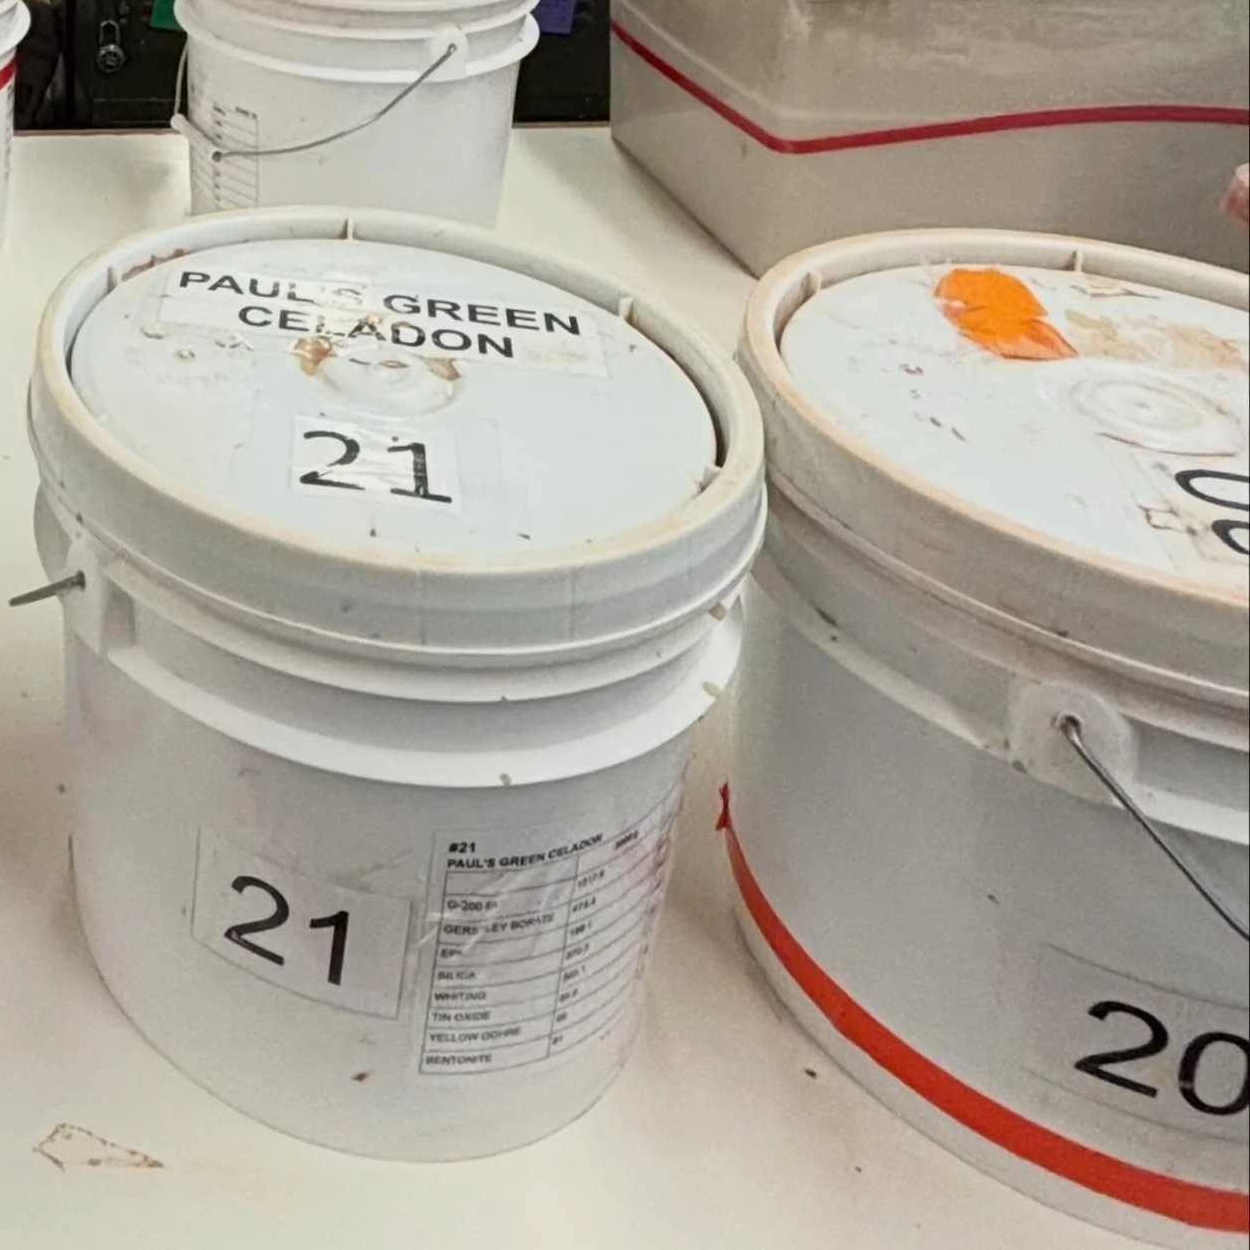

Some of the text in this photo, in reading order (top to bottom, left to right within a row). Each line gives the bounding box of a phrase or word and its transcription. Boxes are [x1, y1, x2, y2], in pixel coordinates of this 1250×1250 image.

[383, 294, 580, 335] GREEN
[238, 306, 514, 358] CELADON
[300, 430, 452, 503] 21
[448, 842, 476, 853] #21
[447, 858, 496, 869] PAUL'S
[499, 852, 545, 867] GREEN
[447, 899, 483, 912] G-200
[223, 875, 350, 985] 21
[434, 991, 487, 1001] WHITING
[432, 1011, 491, 1022] TIN OXIDE
[430, 1026, 522, 1043] YELLOW OCHRE
[425, 1054, 492, 1065] BENTONITE
[1074, 1001, 1249, 1115] 20
